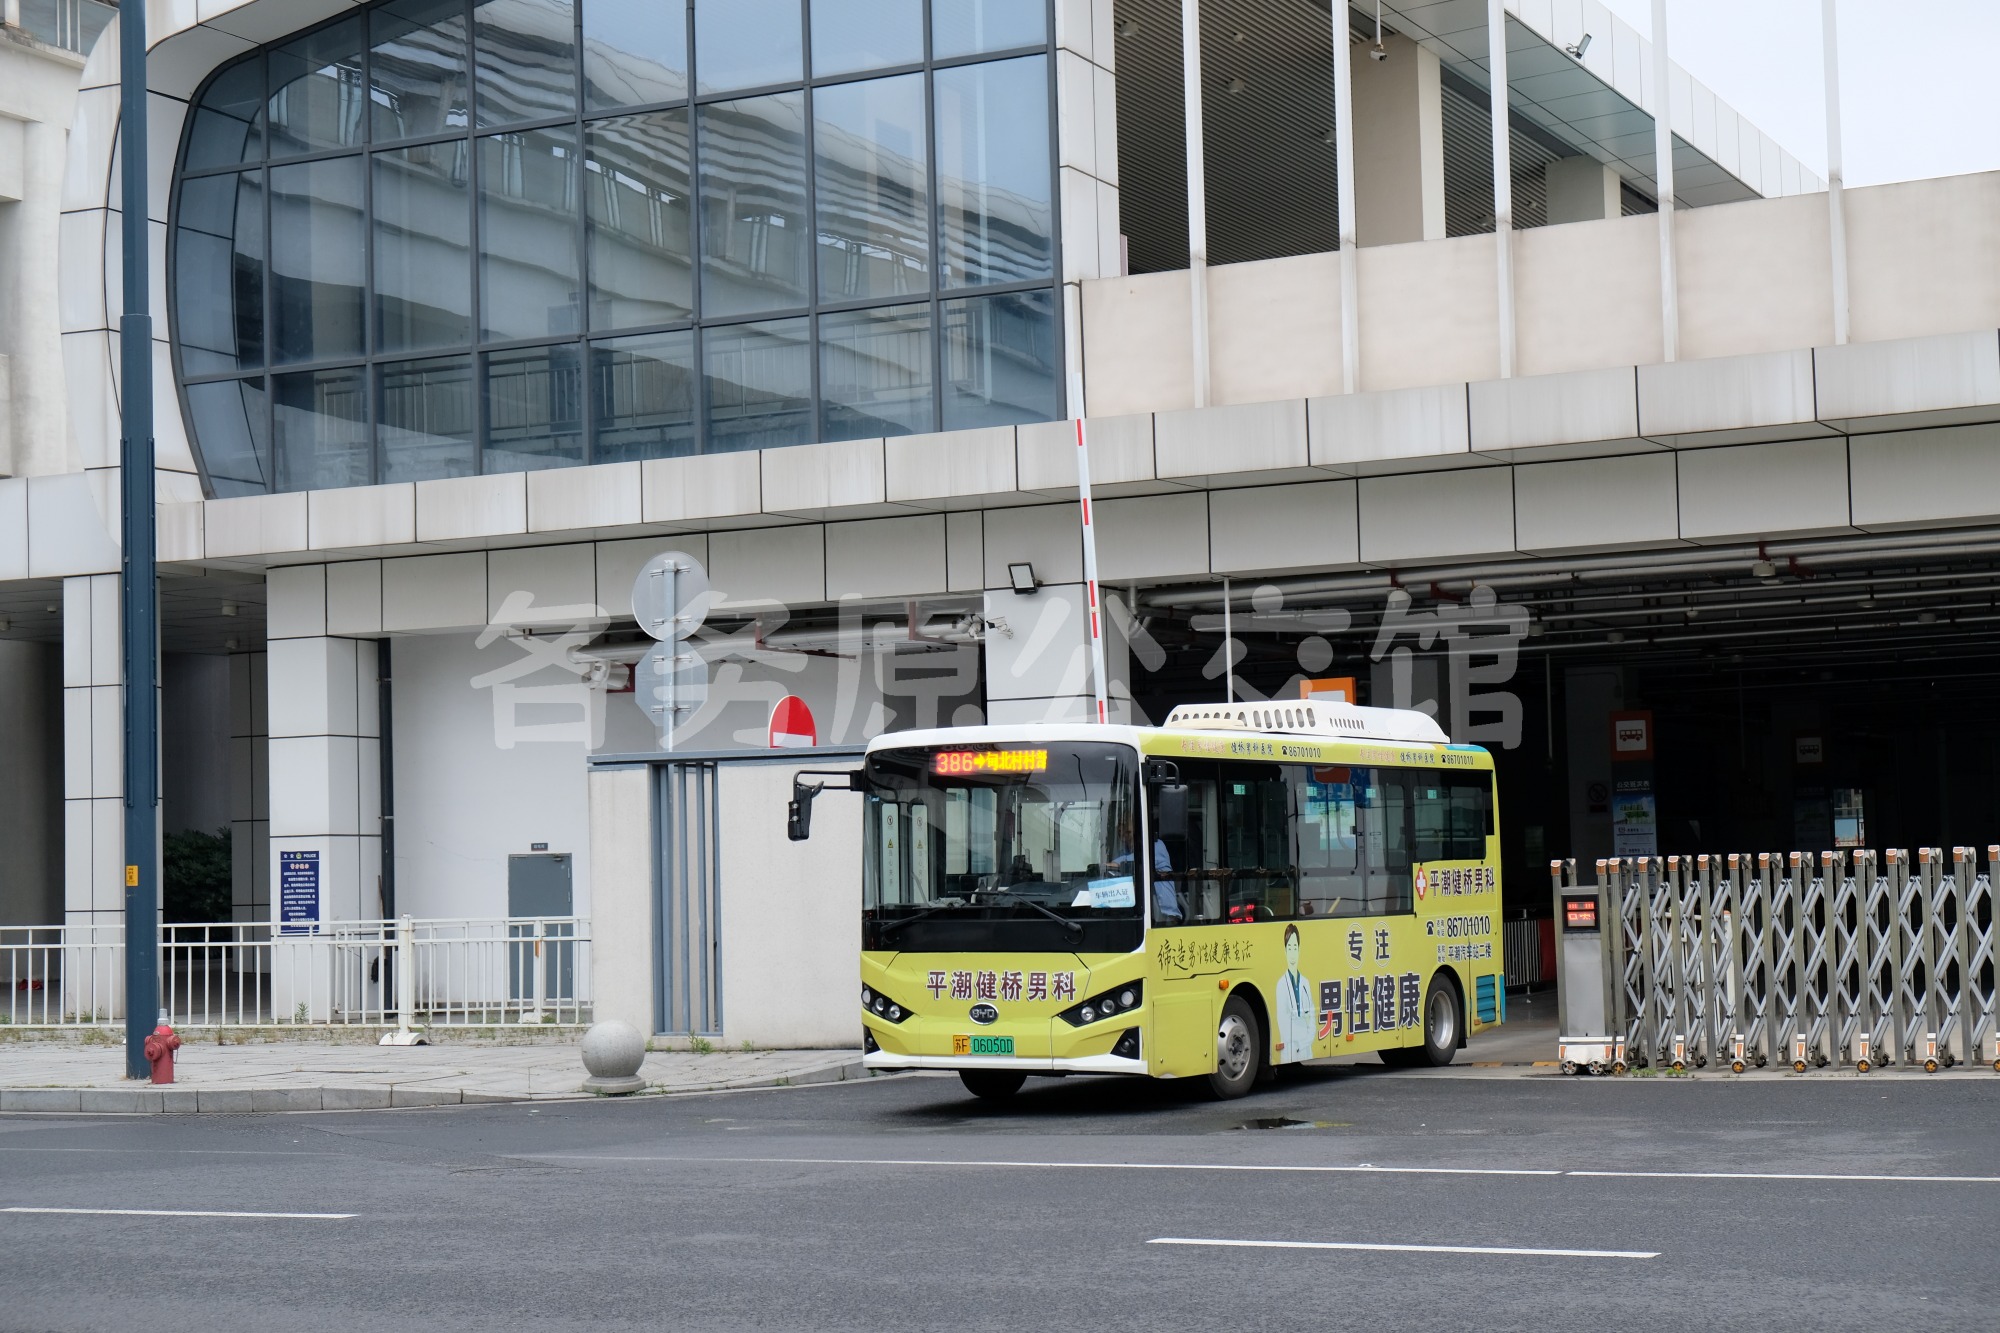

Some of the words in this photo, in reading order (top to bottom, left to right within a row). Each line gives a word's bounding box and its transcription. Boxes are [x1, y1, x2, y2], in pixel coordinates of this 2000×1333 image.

[1288, 746, 1321, 758] 86701010
[1447, 755, 1474, 765] 86701010
[937, 753, 973, 773] 386
[1430, 868, 1494, 896] 平潮健桥男科
[1447, 915, 1490, 937] 86701010
[1348, 929, 1390, 961] 专注
[1448, 942, 1492, 962] 平潮汽车站二楼
[1157, 939, 1254, 976] 缔造男性健康生活
[926, 970, 1077, 1001] 平潮健桥男科
[972, 1008, 995, 1018] BYD
[1318, 971, 1421, 1040] 男性健康
[955, 1038, 969, 1053] 苏F
[973, 1039, 1013, 1054] 06050D
